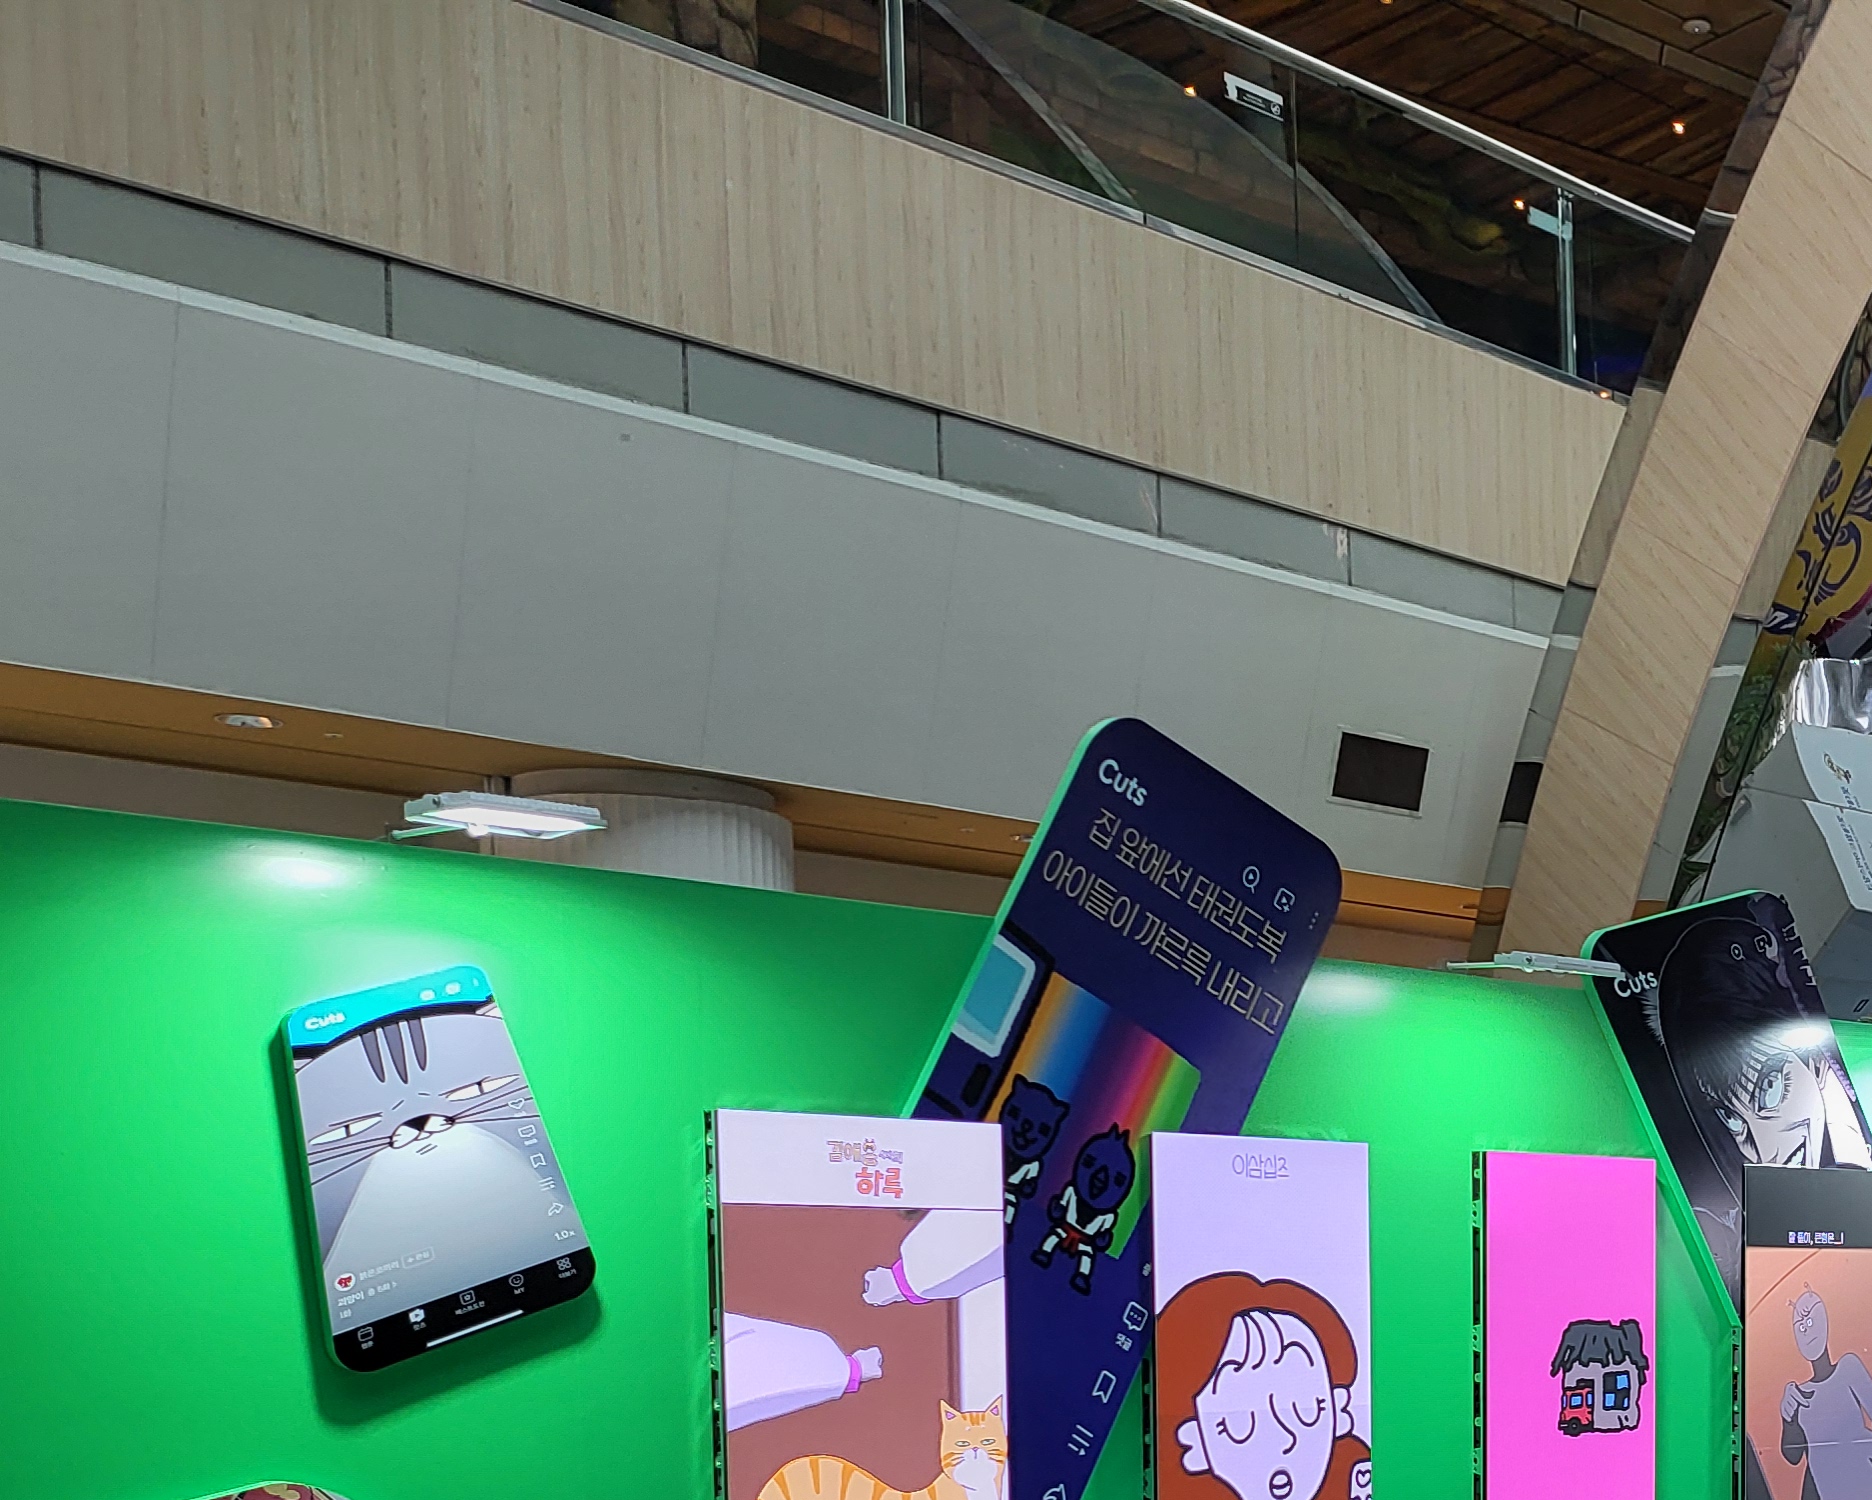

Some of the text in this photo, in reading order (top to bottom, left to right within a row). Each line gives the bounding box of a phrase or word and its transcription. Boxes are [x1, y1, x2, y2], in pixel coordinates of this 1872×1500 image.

[1098, 758, 1148, 806] Cuts
[1089, 808, 1287, 964] 집 앞에선 태권도복
[1042, 849, 1139, 937] 아이들이
[1206, 959, 1285, 1036] 내리고
[1613, 970, 1658, 999] Cuts
[305, 1011, 345, 1031] Cuts
[1232, 1153, 1290, 1179] 이삼십즈
[855, 1167, 903, 1198] 하루
[554, 1230, 576, 1241] 1.0x
[1116, 1333, 1133, 1351] 댓글
